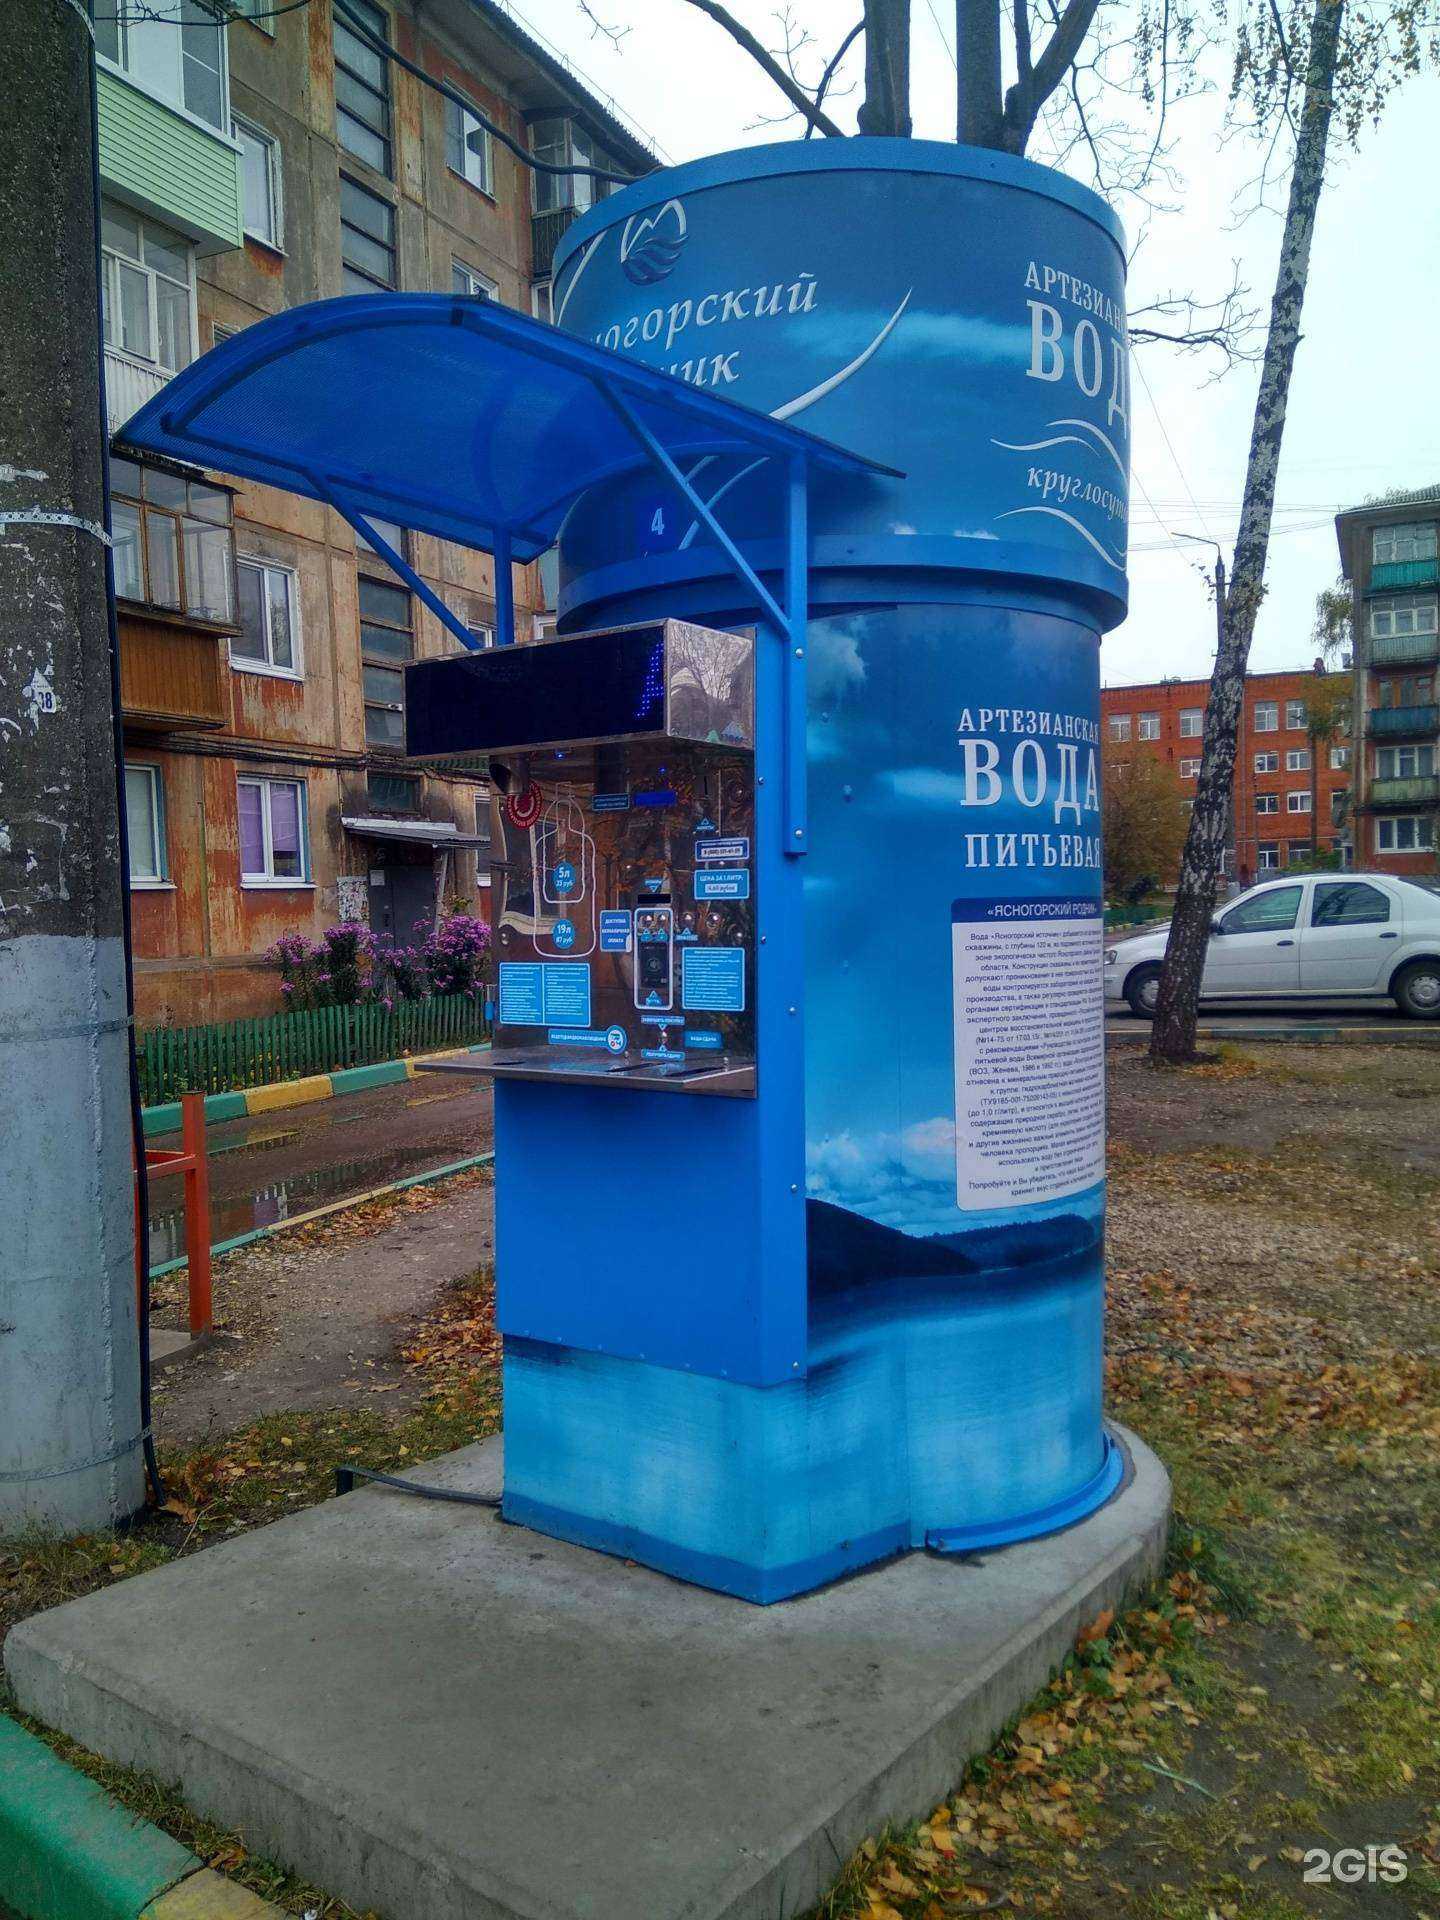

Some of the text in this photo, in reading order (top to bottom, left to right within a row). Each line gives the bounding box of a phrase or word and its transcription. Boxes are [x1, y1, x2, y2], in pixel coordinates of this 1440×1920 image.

[591, 273, 818, 350] огорский
[957, 708, 1098, 745] АРТЕЗИАНСКАЯ
[958, 739, 1099, 825] ВОДА
[965, 834, 1100, 868] ПИТЬЕВАЯ
[988, 902, 1071, 916] «ЯСНОГОРСКИЙ
[970, 932, 988, 941] Вода
[1002, 983, 1048, 991] контролируется
[966, 1016, 1010, 1024] экспертного
[985, 1045, 1038, 1055] рекомендациями
[974, 1056, 1008, 1065] питьевой
[976, 1140, 1000, 1149] другие
[998, 1157, 1040, 1166] использовать
[968, 1180, 1011, 1190] Попробуйте
